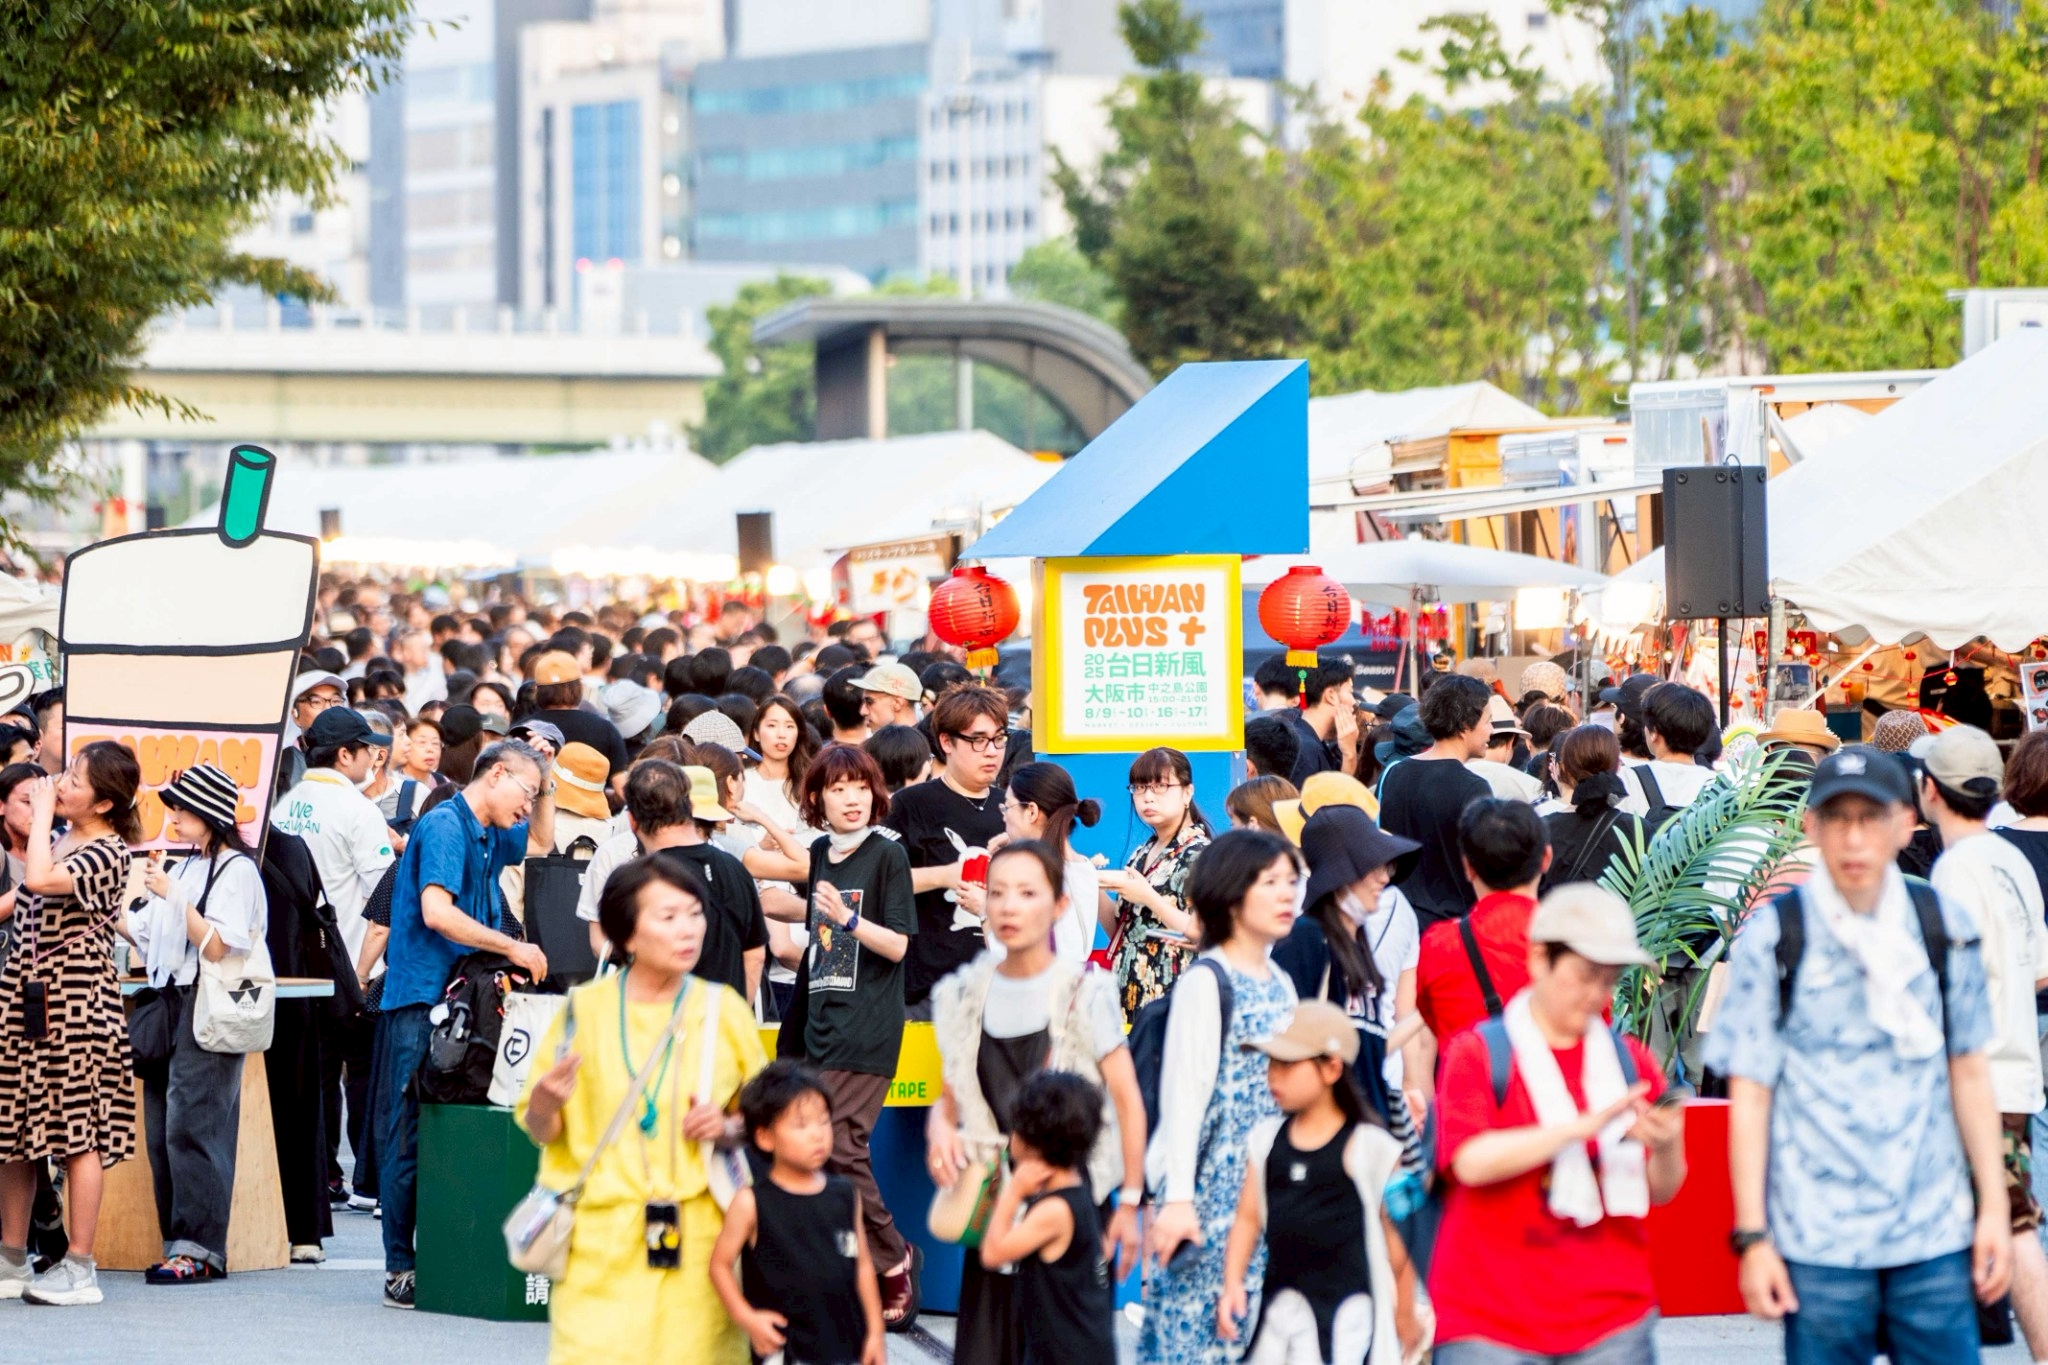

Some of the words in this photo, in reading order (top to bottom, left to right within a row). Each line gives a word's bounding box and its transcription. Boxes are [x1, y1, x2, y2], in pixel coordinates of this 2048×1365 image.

[1083, 583, 1205, 615] TAIWAN
[1084, 616, 1168, 647] PLUS
[1084, 653, 1105, 665] 20
[1106, 652, 1207, 678] 台日新風
[1084, 666, 1105, 678] 25
[1085, 682, 1146, 704] 大阪市
[288, 801, 314, 818] We
